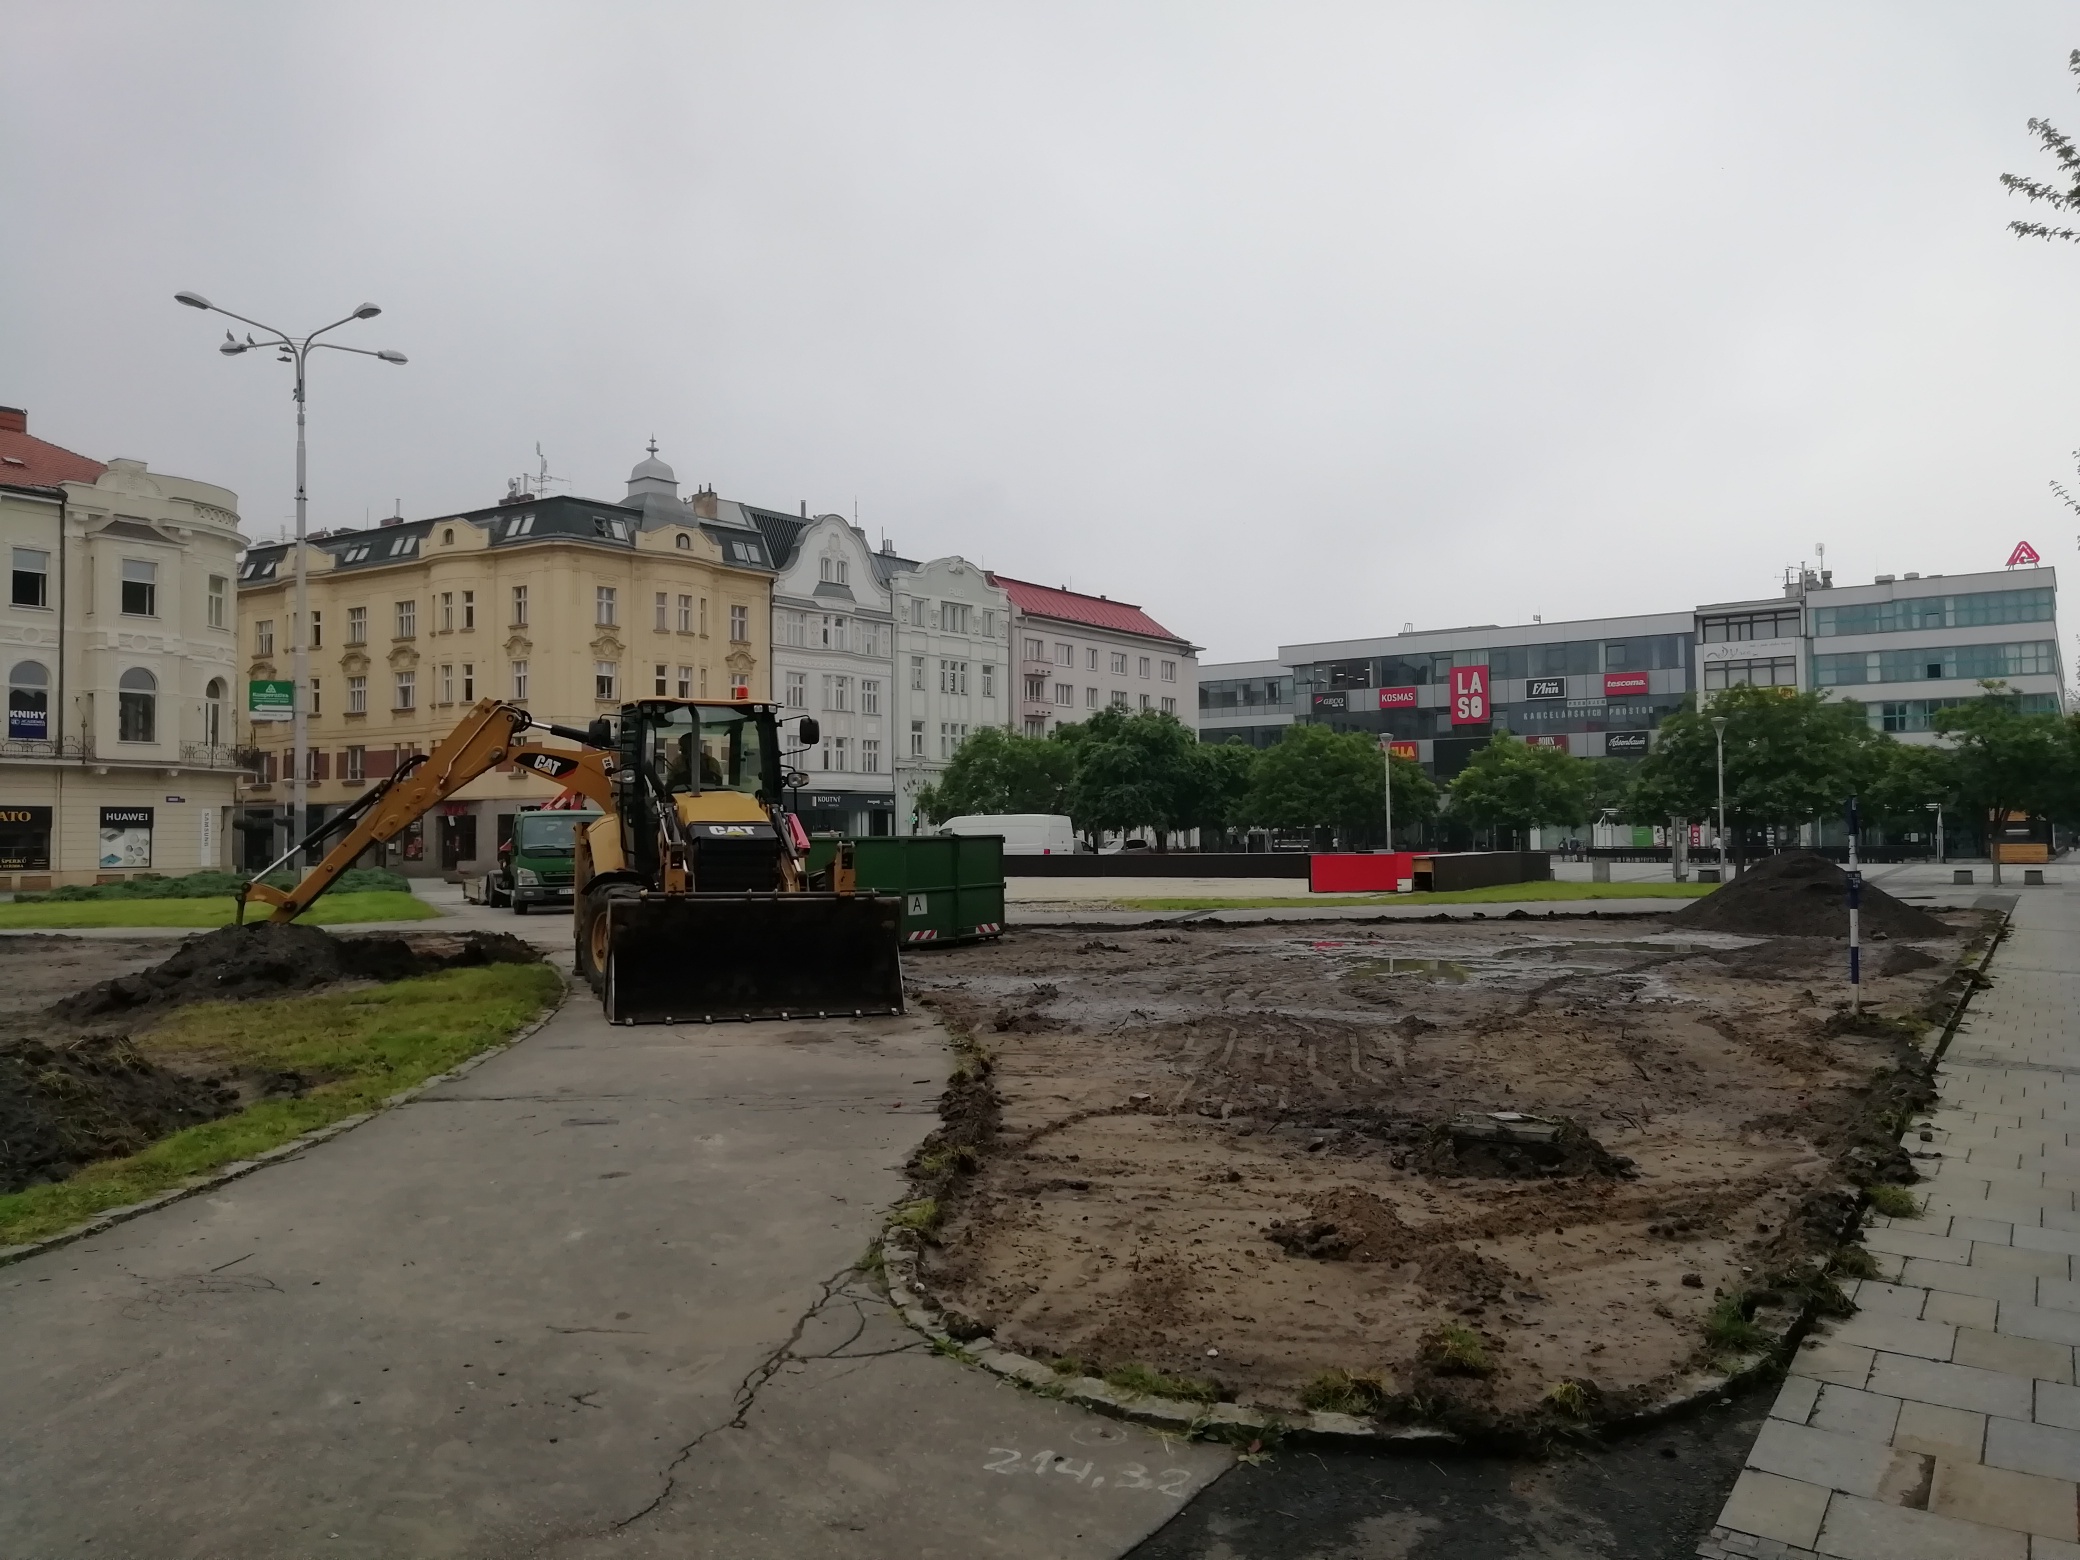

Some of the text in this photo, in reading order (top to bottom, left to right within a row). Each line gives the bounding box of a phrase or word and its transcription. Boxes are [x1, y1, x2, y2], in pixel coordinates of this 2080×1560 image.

[1457, 671, 1483, 694] LA
[1323, 697, 1344, 705] GECO
[1381, 692, 1414, 702] KOSMAS
[1457, 695, 1483, 719] SO
[10, 710, 46, 719] KNIHY
[533, 754, 561, 776] CAT
[106, 813, 148, 821] HUAWEI
[709, 826, 755, 836] CAT
[913, 897, 922, 912] A
[982, 1447, 1192, 1498] 214,32
